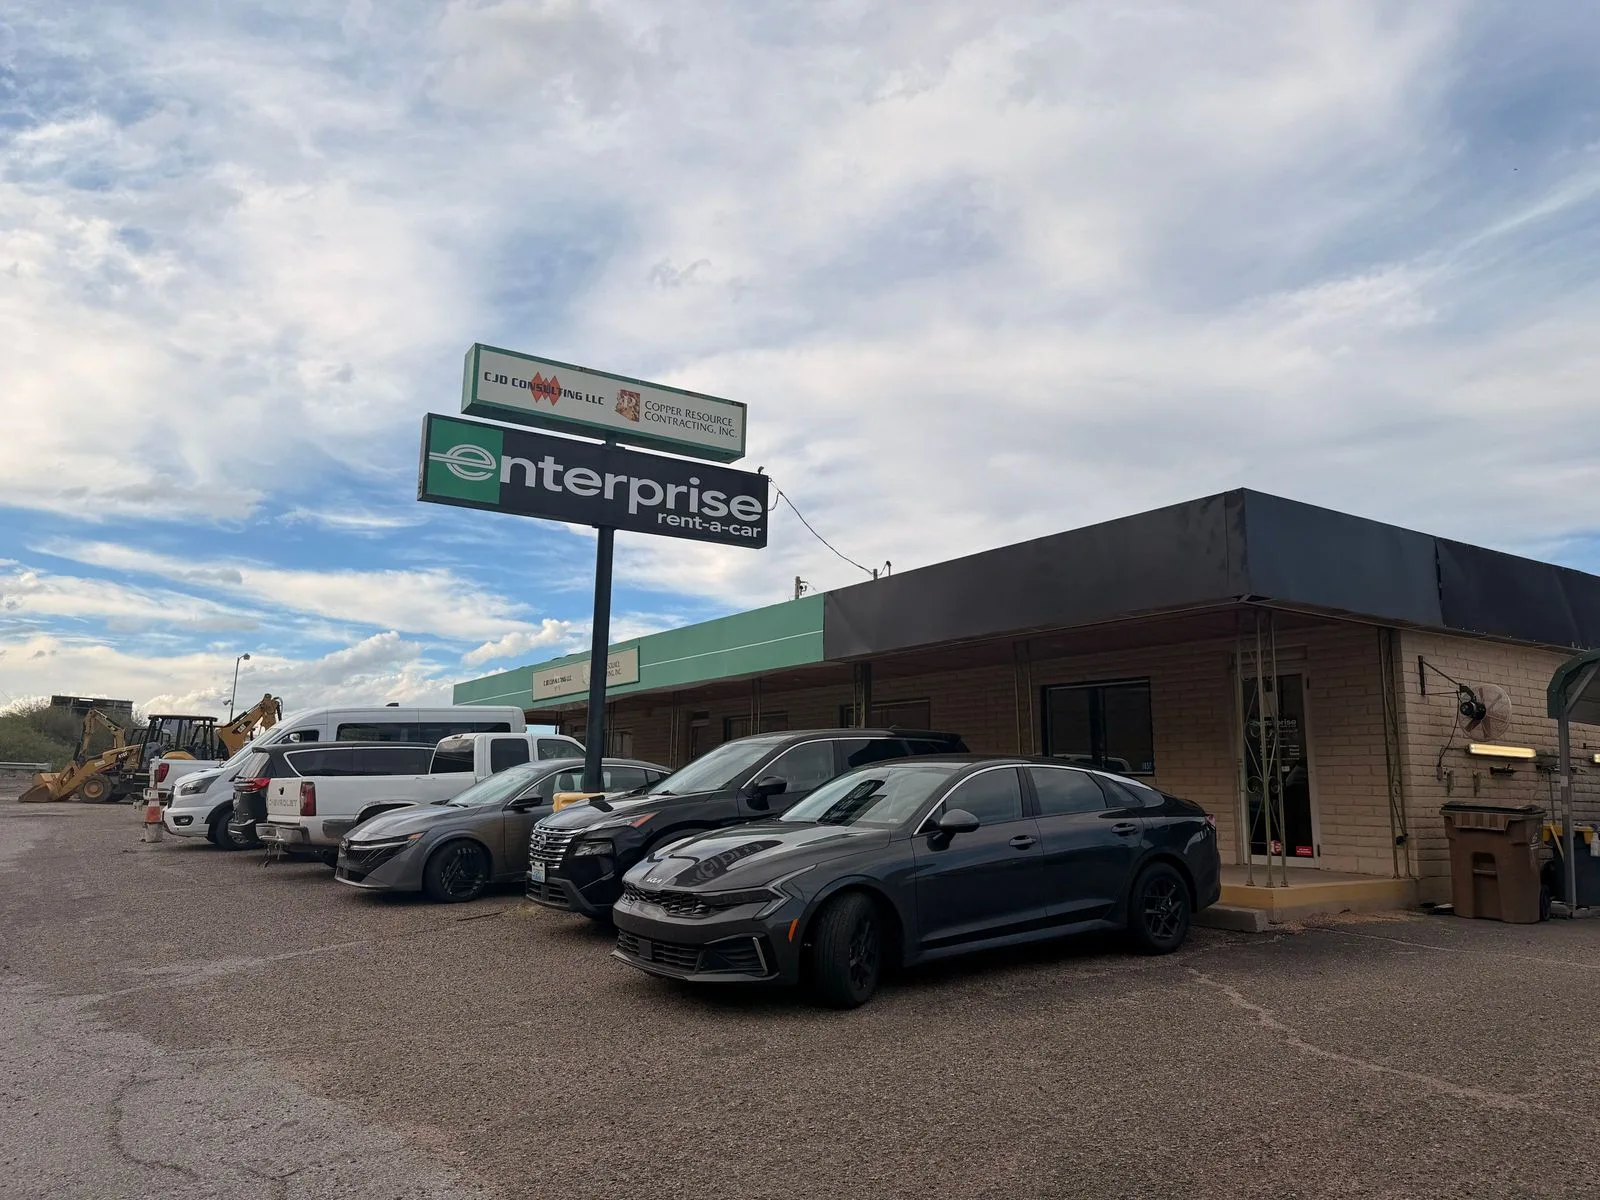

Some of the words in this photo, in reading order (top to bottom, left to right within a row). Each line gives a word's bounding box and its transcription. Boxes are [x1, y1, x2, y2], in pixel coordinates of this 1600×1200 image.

[484, 371, 508, 385] CJD
[511, 377, 583, 401] CONSULTING
[585, 393, 605, 406] LLC
[644, 400, 682, 417] COPPER
[685, 408, 733, 427] RESOURCE
[719, 425, 738, 438] INC.
[429, 444, 763, 522] enterprise
[657, 511, 761, 538] rent-a-car
[646, 876, 663, 884] KIA
